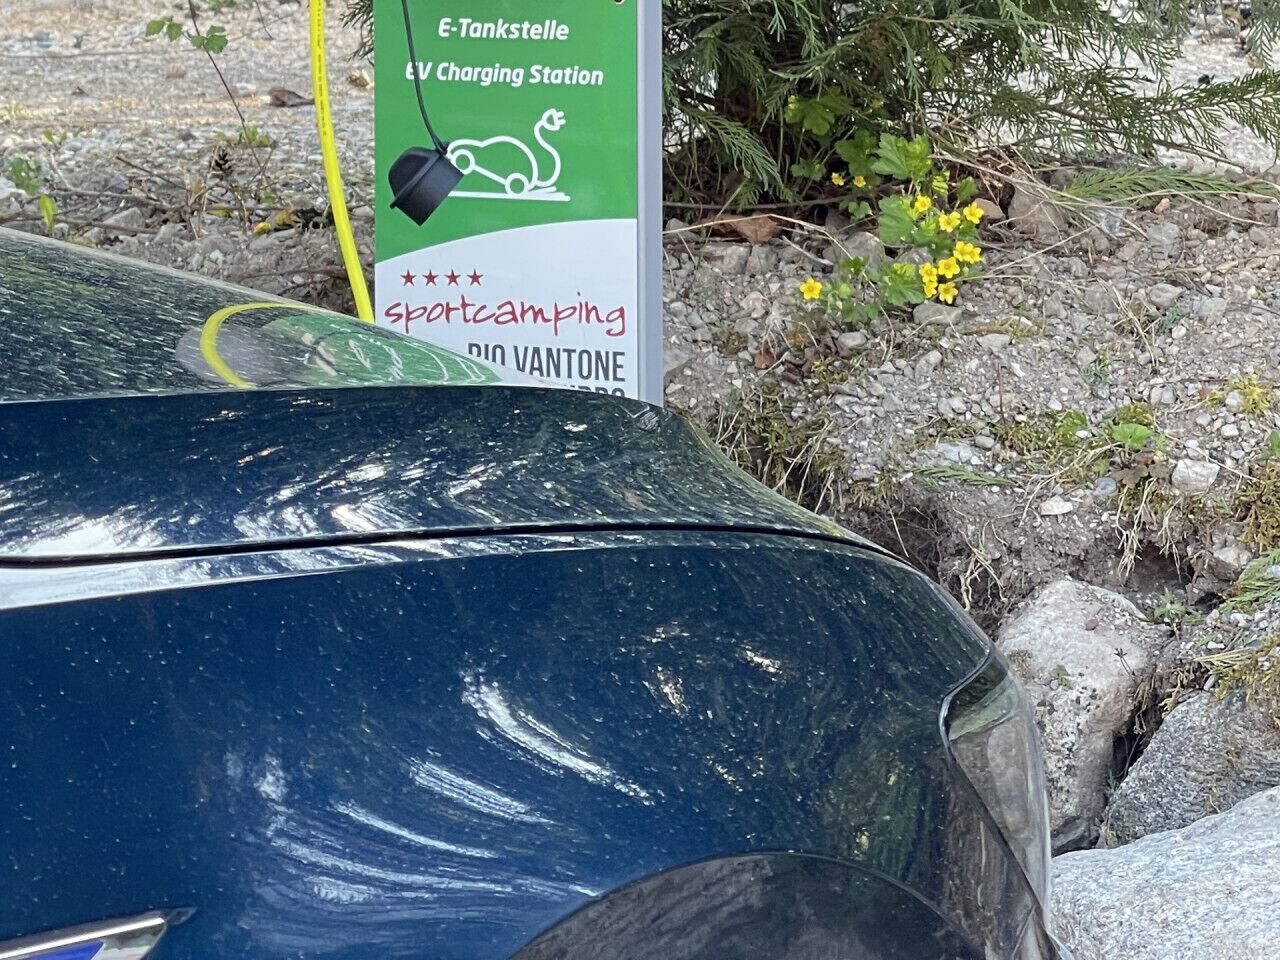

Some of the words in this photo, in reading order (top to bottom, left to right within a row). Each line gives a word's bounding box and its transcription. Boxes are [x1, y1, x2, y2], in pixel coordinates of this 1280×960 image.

[437, 17, 570, 40] E-Tankstelle
[436, 62, 525, 87] Charging
[528, 64, 604, 86] Station
[384, 291, 626, 337] sportcamping
[513, 345, 626, 382] VANTONE
